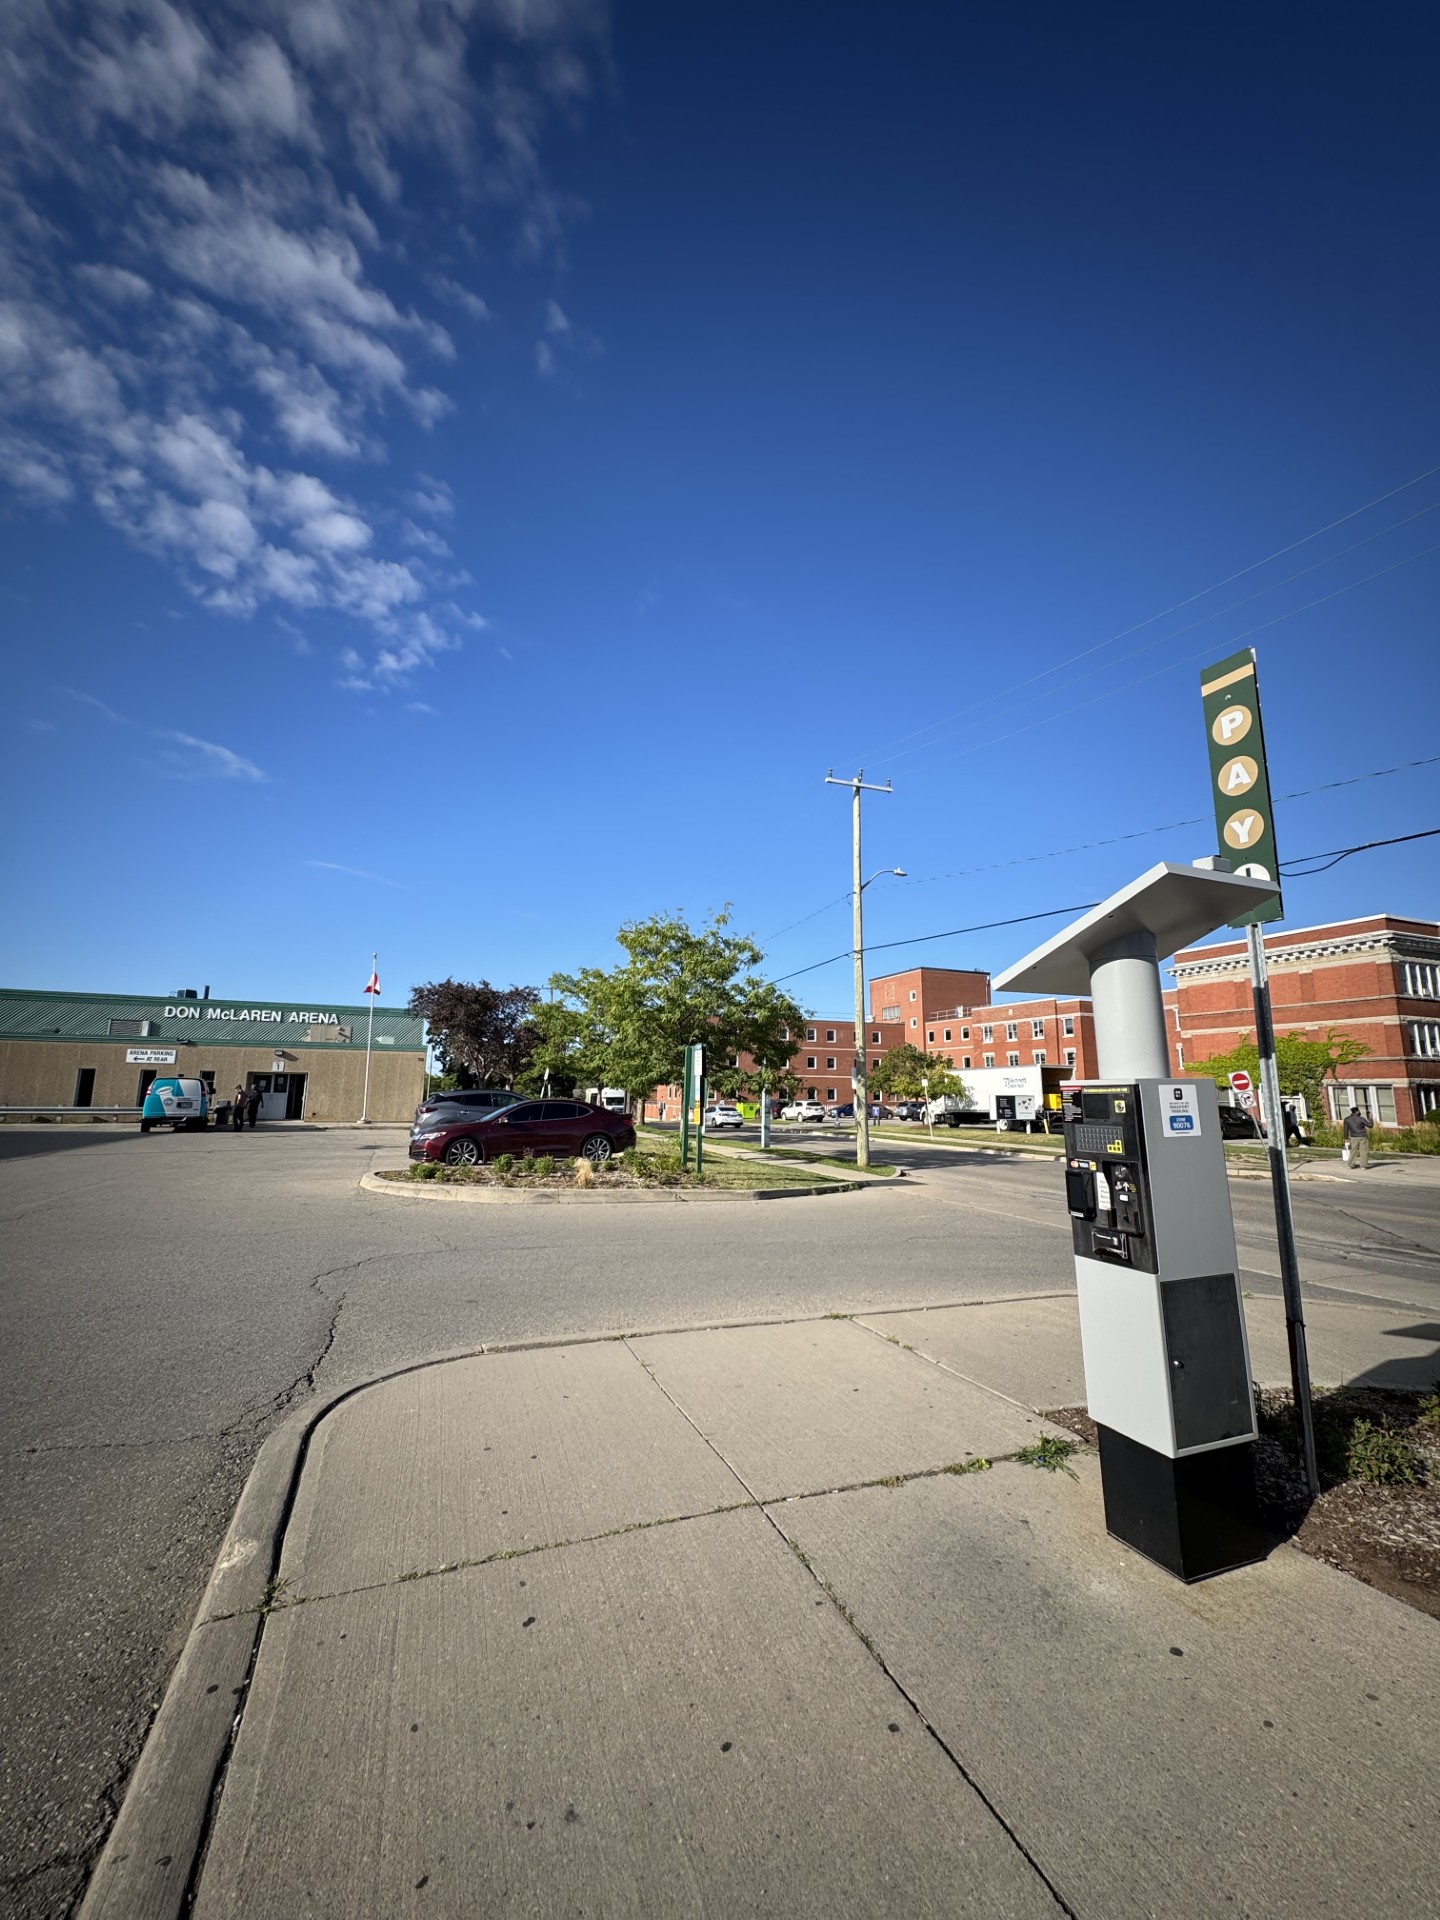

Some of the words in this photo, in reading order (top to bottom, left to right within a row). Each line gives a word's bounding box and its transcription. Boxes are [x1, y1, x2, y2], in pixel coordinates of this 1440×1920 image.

[1220, 709, 1255, 844] PAY
[164, 1006, 201, 1019] DON
[207, 1007, 282, 1022] McLAREN
[288, 1011, 339, 1025] ARENA
